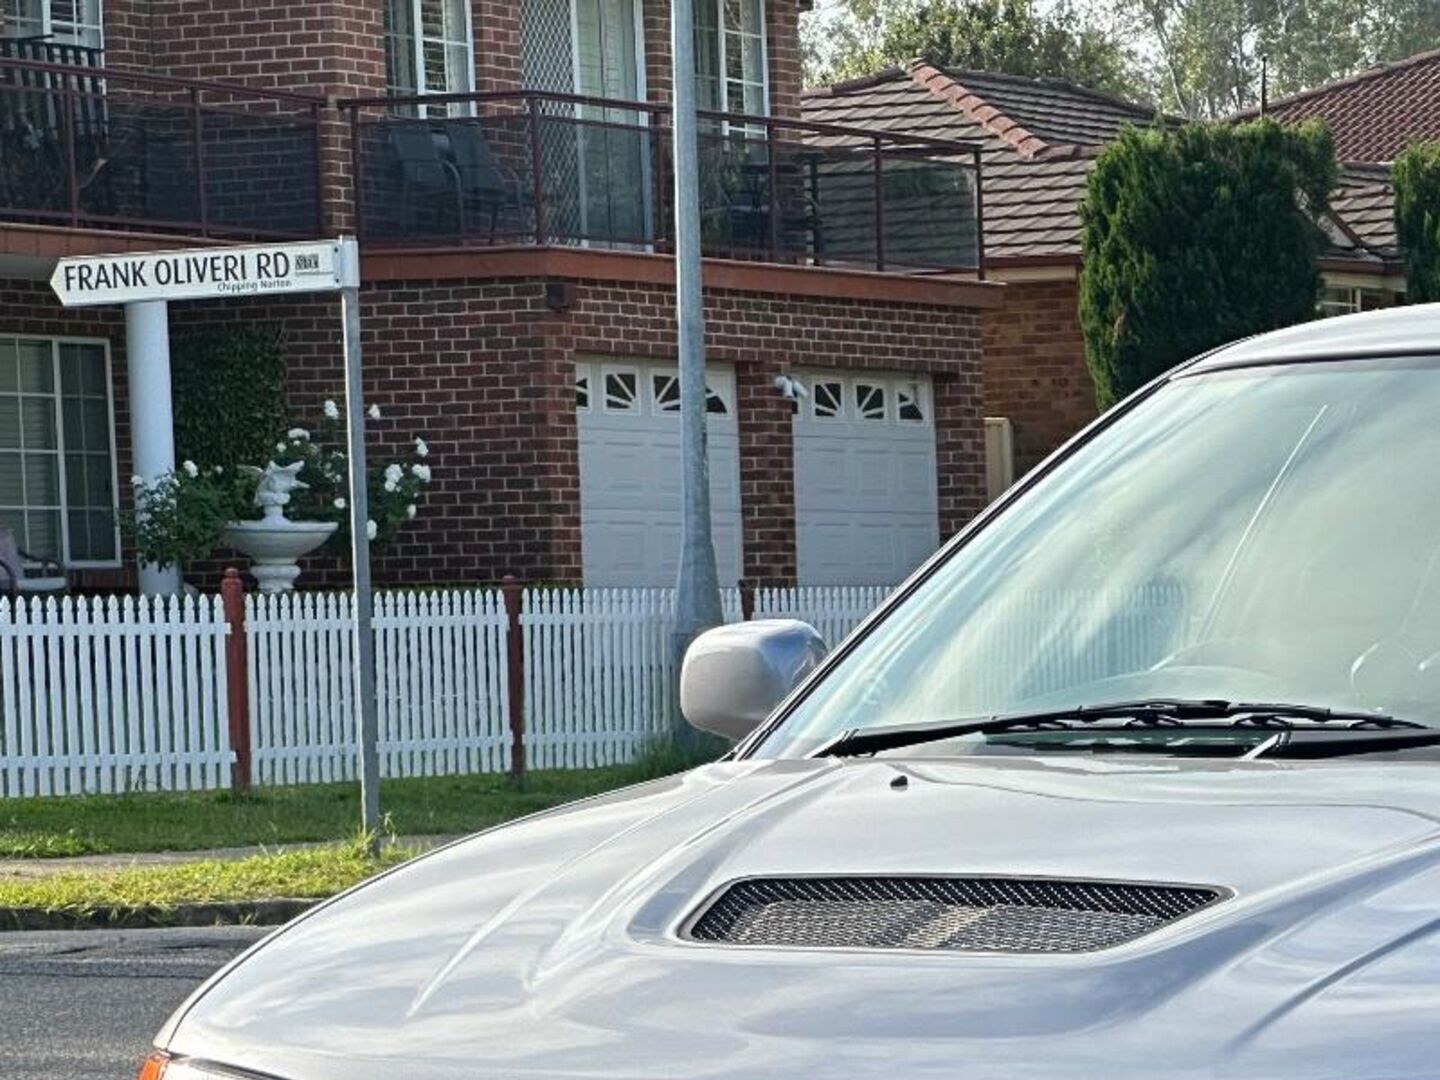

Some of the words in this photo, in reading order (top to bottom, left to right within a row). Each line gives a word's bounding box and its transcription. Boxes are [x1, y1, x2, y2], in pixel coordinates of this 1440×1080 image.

[64, 261, 146, 292] FRANK
[154, 254, 247, 286] OLIVERI
[256, 251, 290, 280] RD
[217, 281, 258, 293] Chipping
[260, 279, 292, 289] Norton
